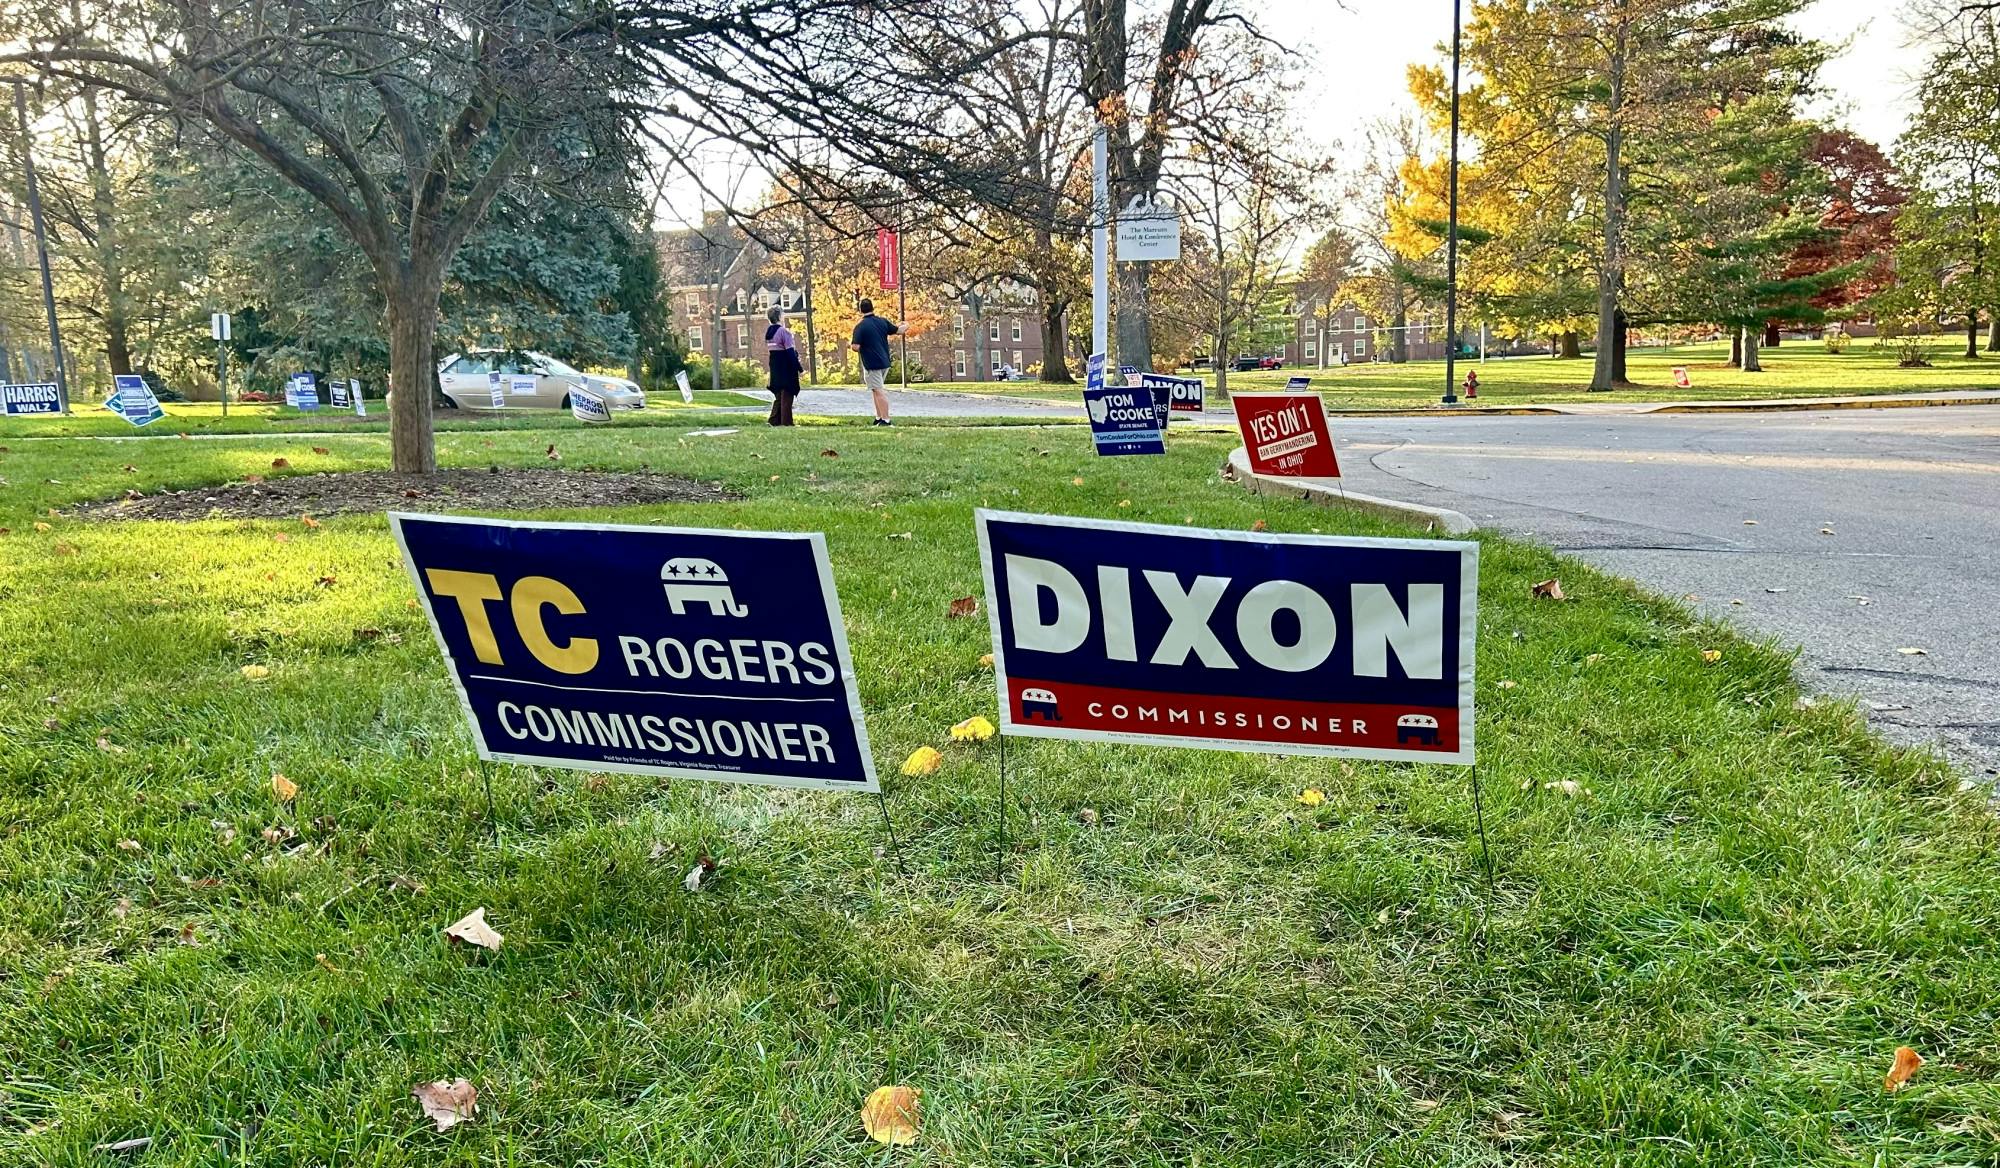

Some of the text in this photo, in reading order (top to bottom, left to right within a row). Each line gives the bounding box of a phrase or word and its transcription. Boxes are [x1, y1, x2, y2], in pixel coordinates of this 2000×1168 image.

[5, 386, 57, 403] HARRIS
[1105, 394, 1134, 407] TOM
[16, 403, 51, 413] WALZ
[1109, 407, 1154, 421] COOKE
[1249, 403, 1311, 443] YES ON 1
[1260, 434, 1315, 457] BAN GERRYMANDERING
[1278, 453, 1304, 469] IN OHIO
[425, 568, 835, 686] TC ROGERS
[1005, 553, 1444, 680] DIXON
[1087, 702, 1369, 735] COMMISSIONER
[497, 701, 836, 764] COMMISSIONER
